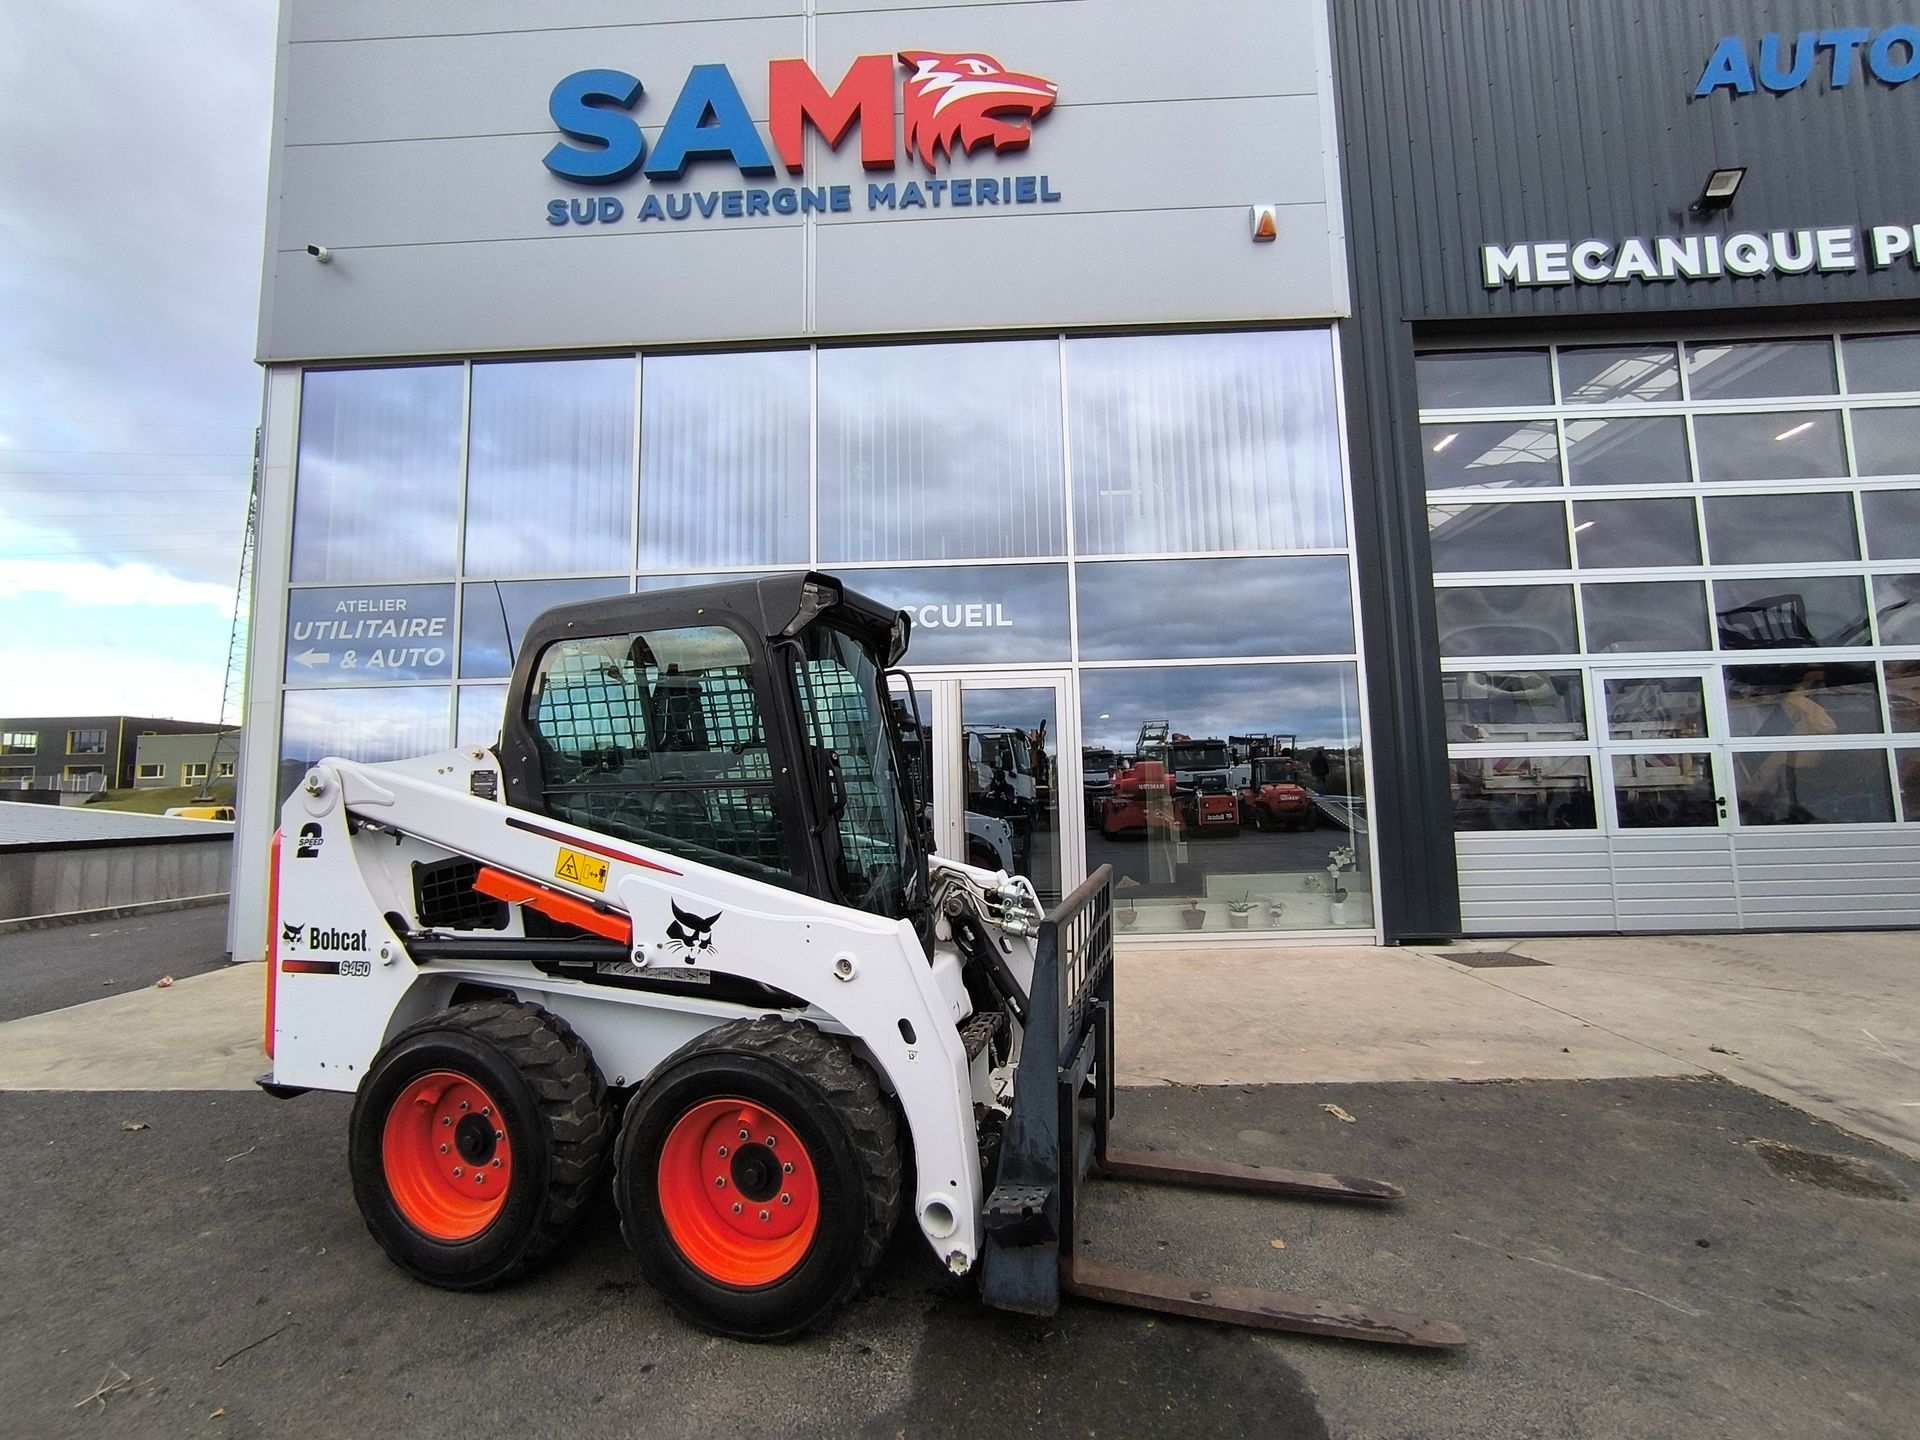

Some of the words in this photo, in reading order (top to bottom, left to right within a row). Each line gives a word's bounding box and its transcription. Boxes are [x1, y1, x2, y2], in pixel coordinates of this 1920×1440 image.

[542, 54, 896, 184] SAM
[546, 197, 623, 225] SUD
[639, 185, 851, 222] AUVERGNE
[867, 175, 1060, 209] MATERIEL
[1482, 226, 1858, 289] MECANIQUE
[335, 599, 407, 613] ATELIER
[293, 617, 446, 641] UTILITAIRE
[340, 650, 358, 669] &
[365, 647, 446, 668] AUTO
[299, 838, 324, 846] SPEED
[310, 927, 367, 951] Bobcat
[340, 961, 371, 976] S450
